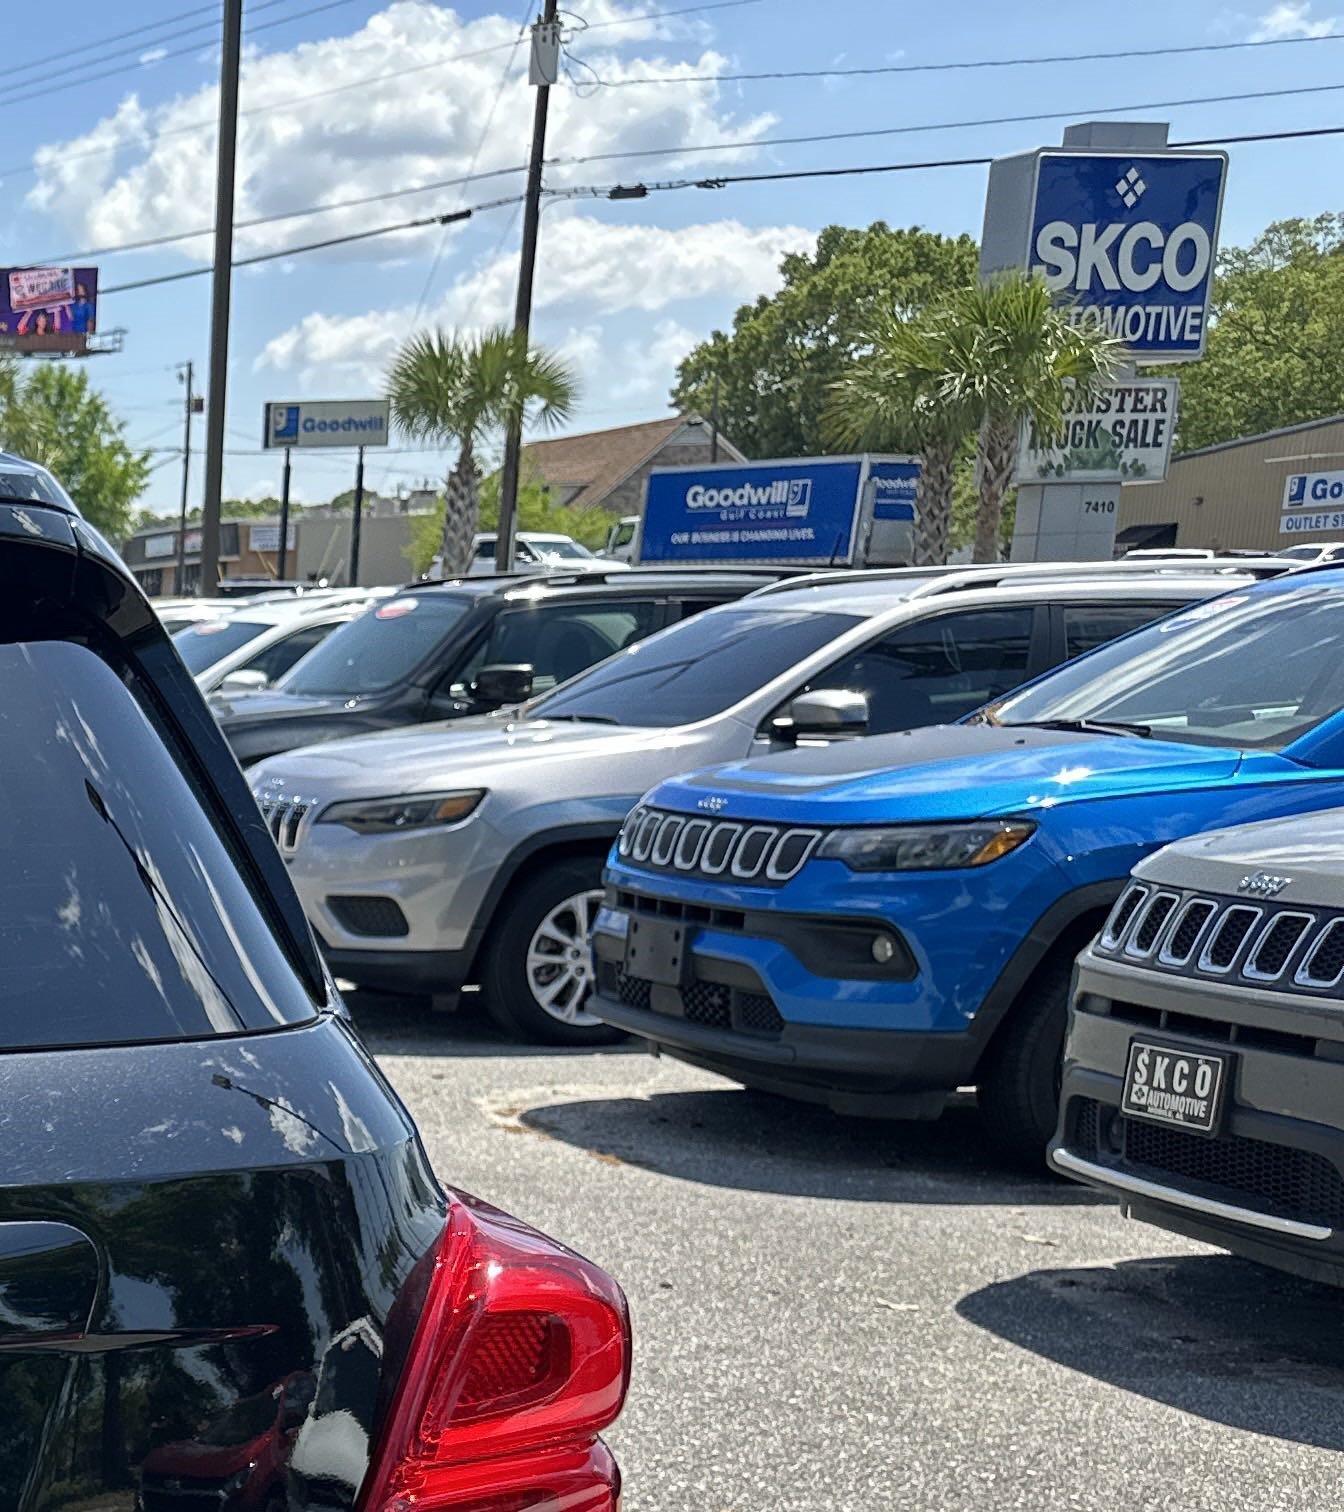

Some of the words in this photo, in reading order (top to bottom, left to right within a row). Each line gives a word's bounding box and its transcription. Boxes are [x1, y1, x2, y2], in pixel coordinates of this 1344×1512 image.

[1032, 221, 1210, 292] SKCO
[1049, 305, 1203, 342] TOMOTIVE
[1060, 386, 1168, 414] ONSTER
[303, 416, 384, 432] Goodwill
[1112, 418, 1166, 449] SALE
[686, 480, 788, 508] Goodwill
[1085, 501, 1115, 513] 7410
[1286, 515, 1329, 530] OUTLET
[1134, 1051, 1212, 1098] SKCO
[1147, 1089, 1208, 1119] AUTOMOTIVE
